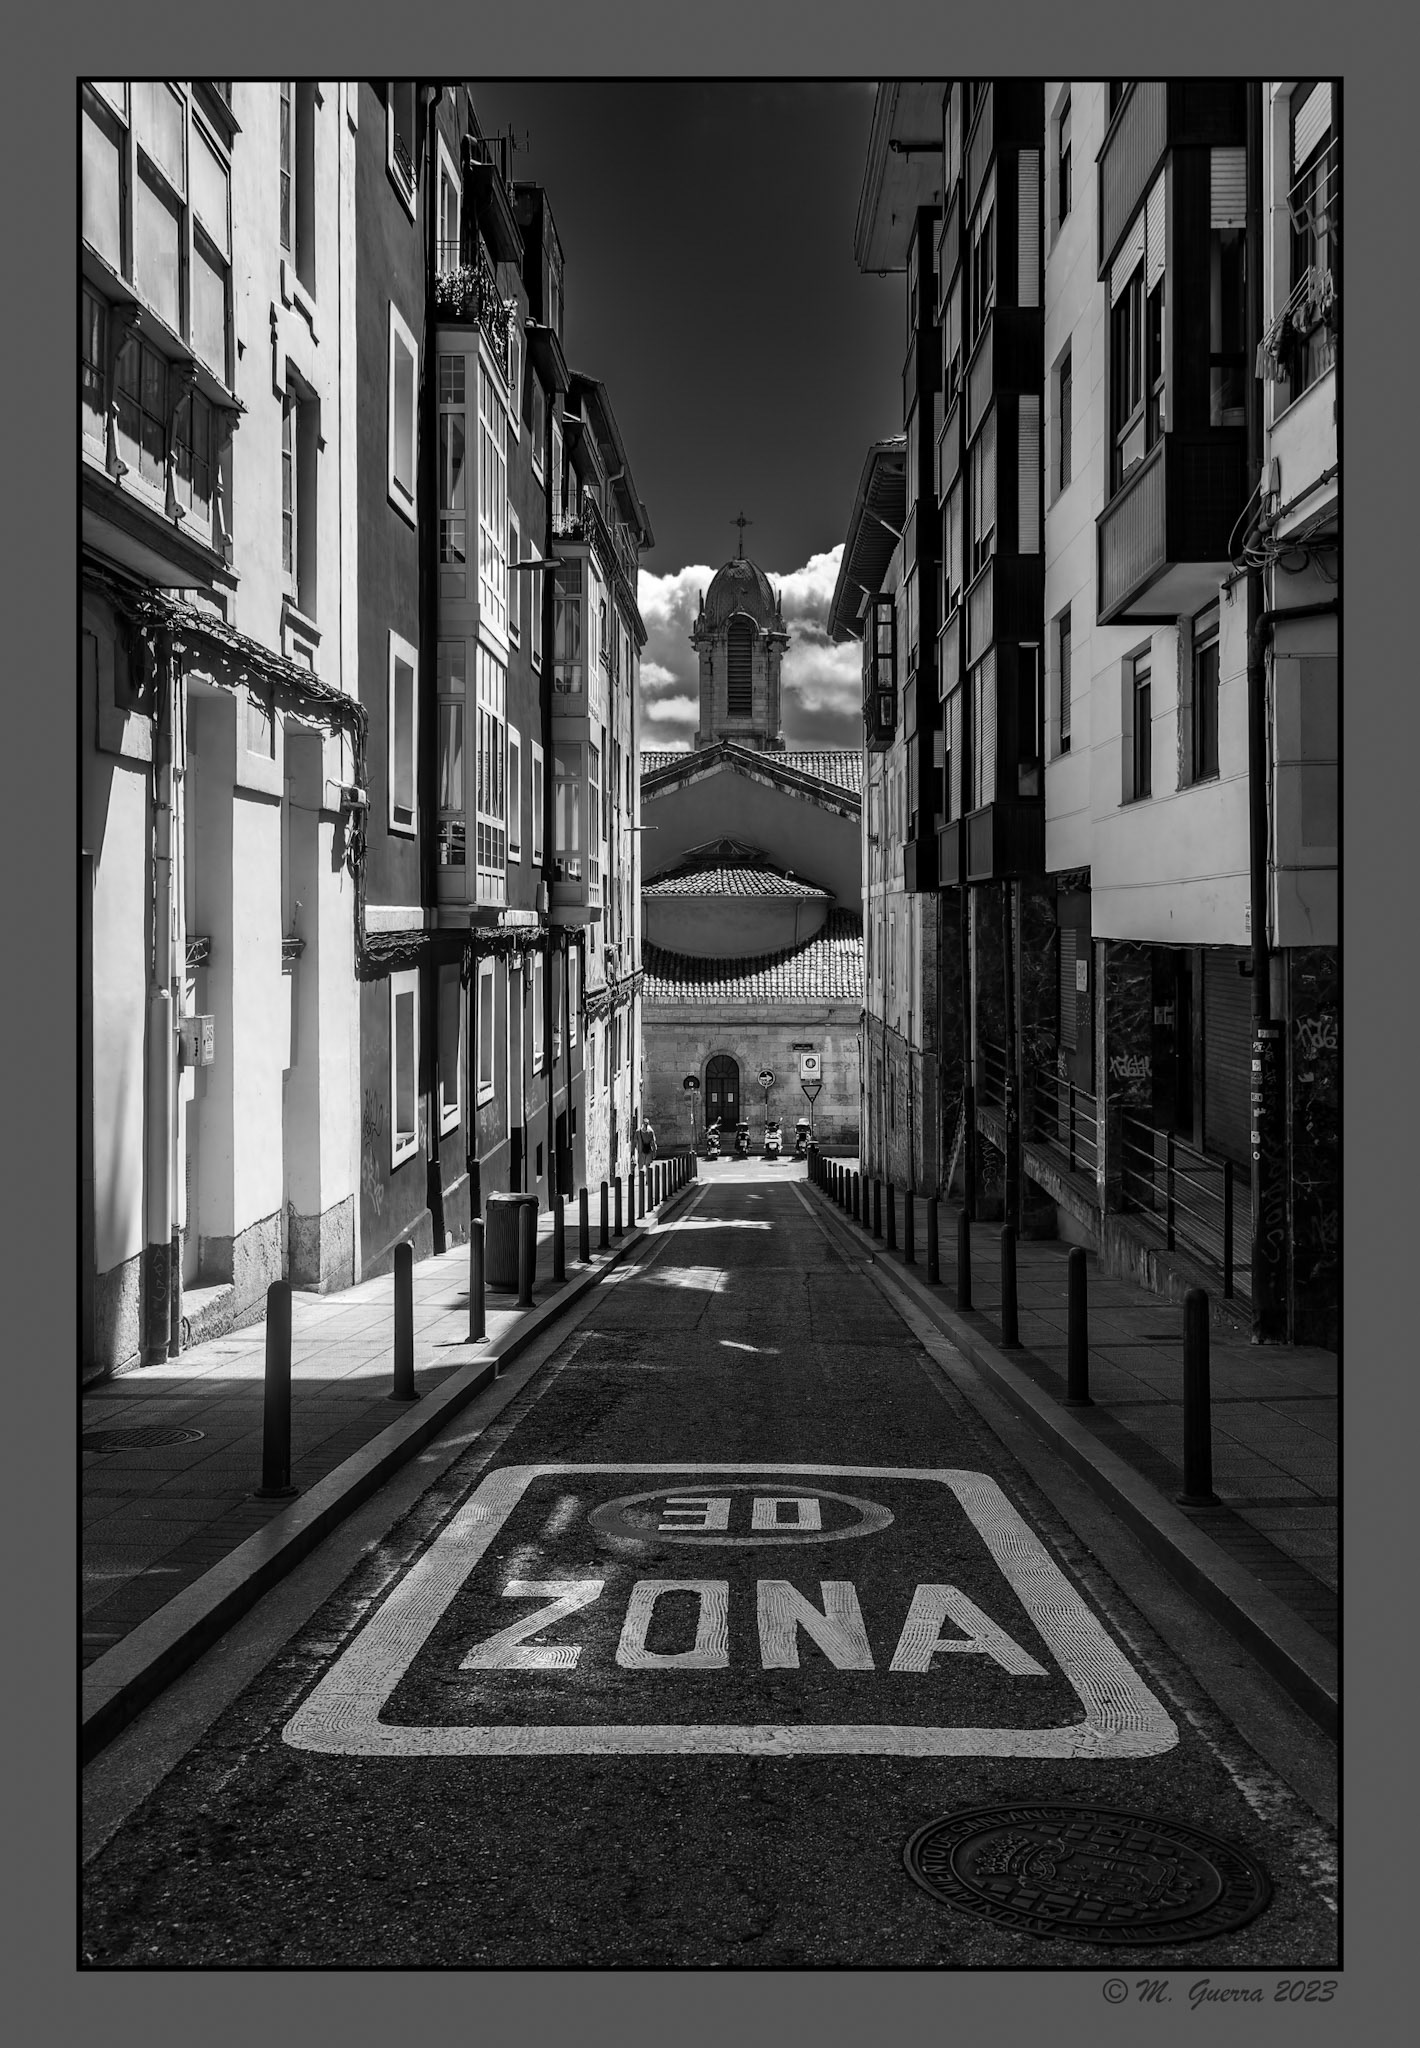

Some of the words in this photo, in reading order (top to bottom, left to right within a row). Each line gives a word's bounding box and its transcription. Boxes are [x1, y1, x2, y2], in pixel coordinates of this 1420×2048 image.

[658, 1497, 822, 1530] 30
[459, 1580, 1050, 1675] ZONA
[956, 1809, 1098, 1835] SANTANDER
[936, 1831, 964, 1852] DE
[922, 1847, 1056, 1931] AYUNTAMIENTO
